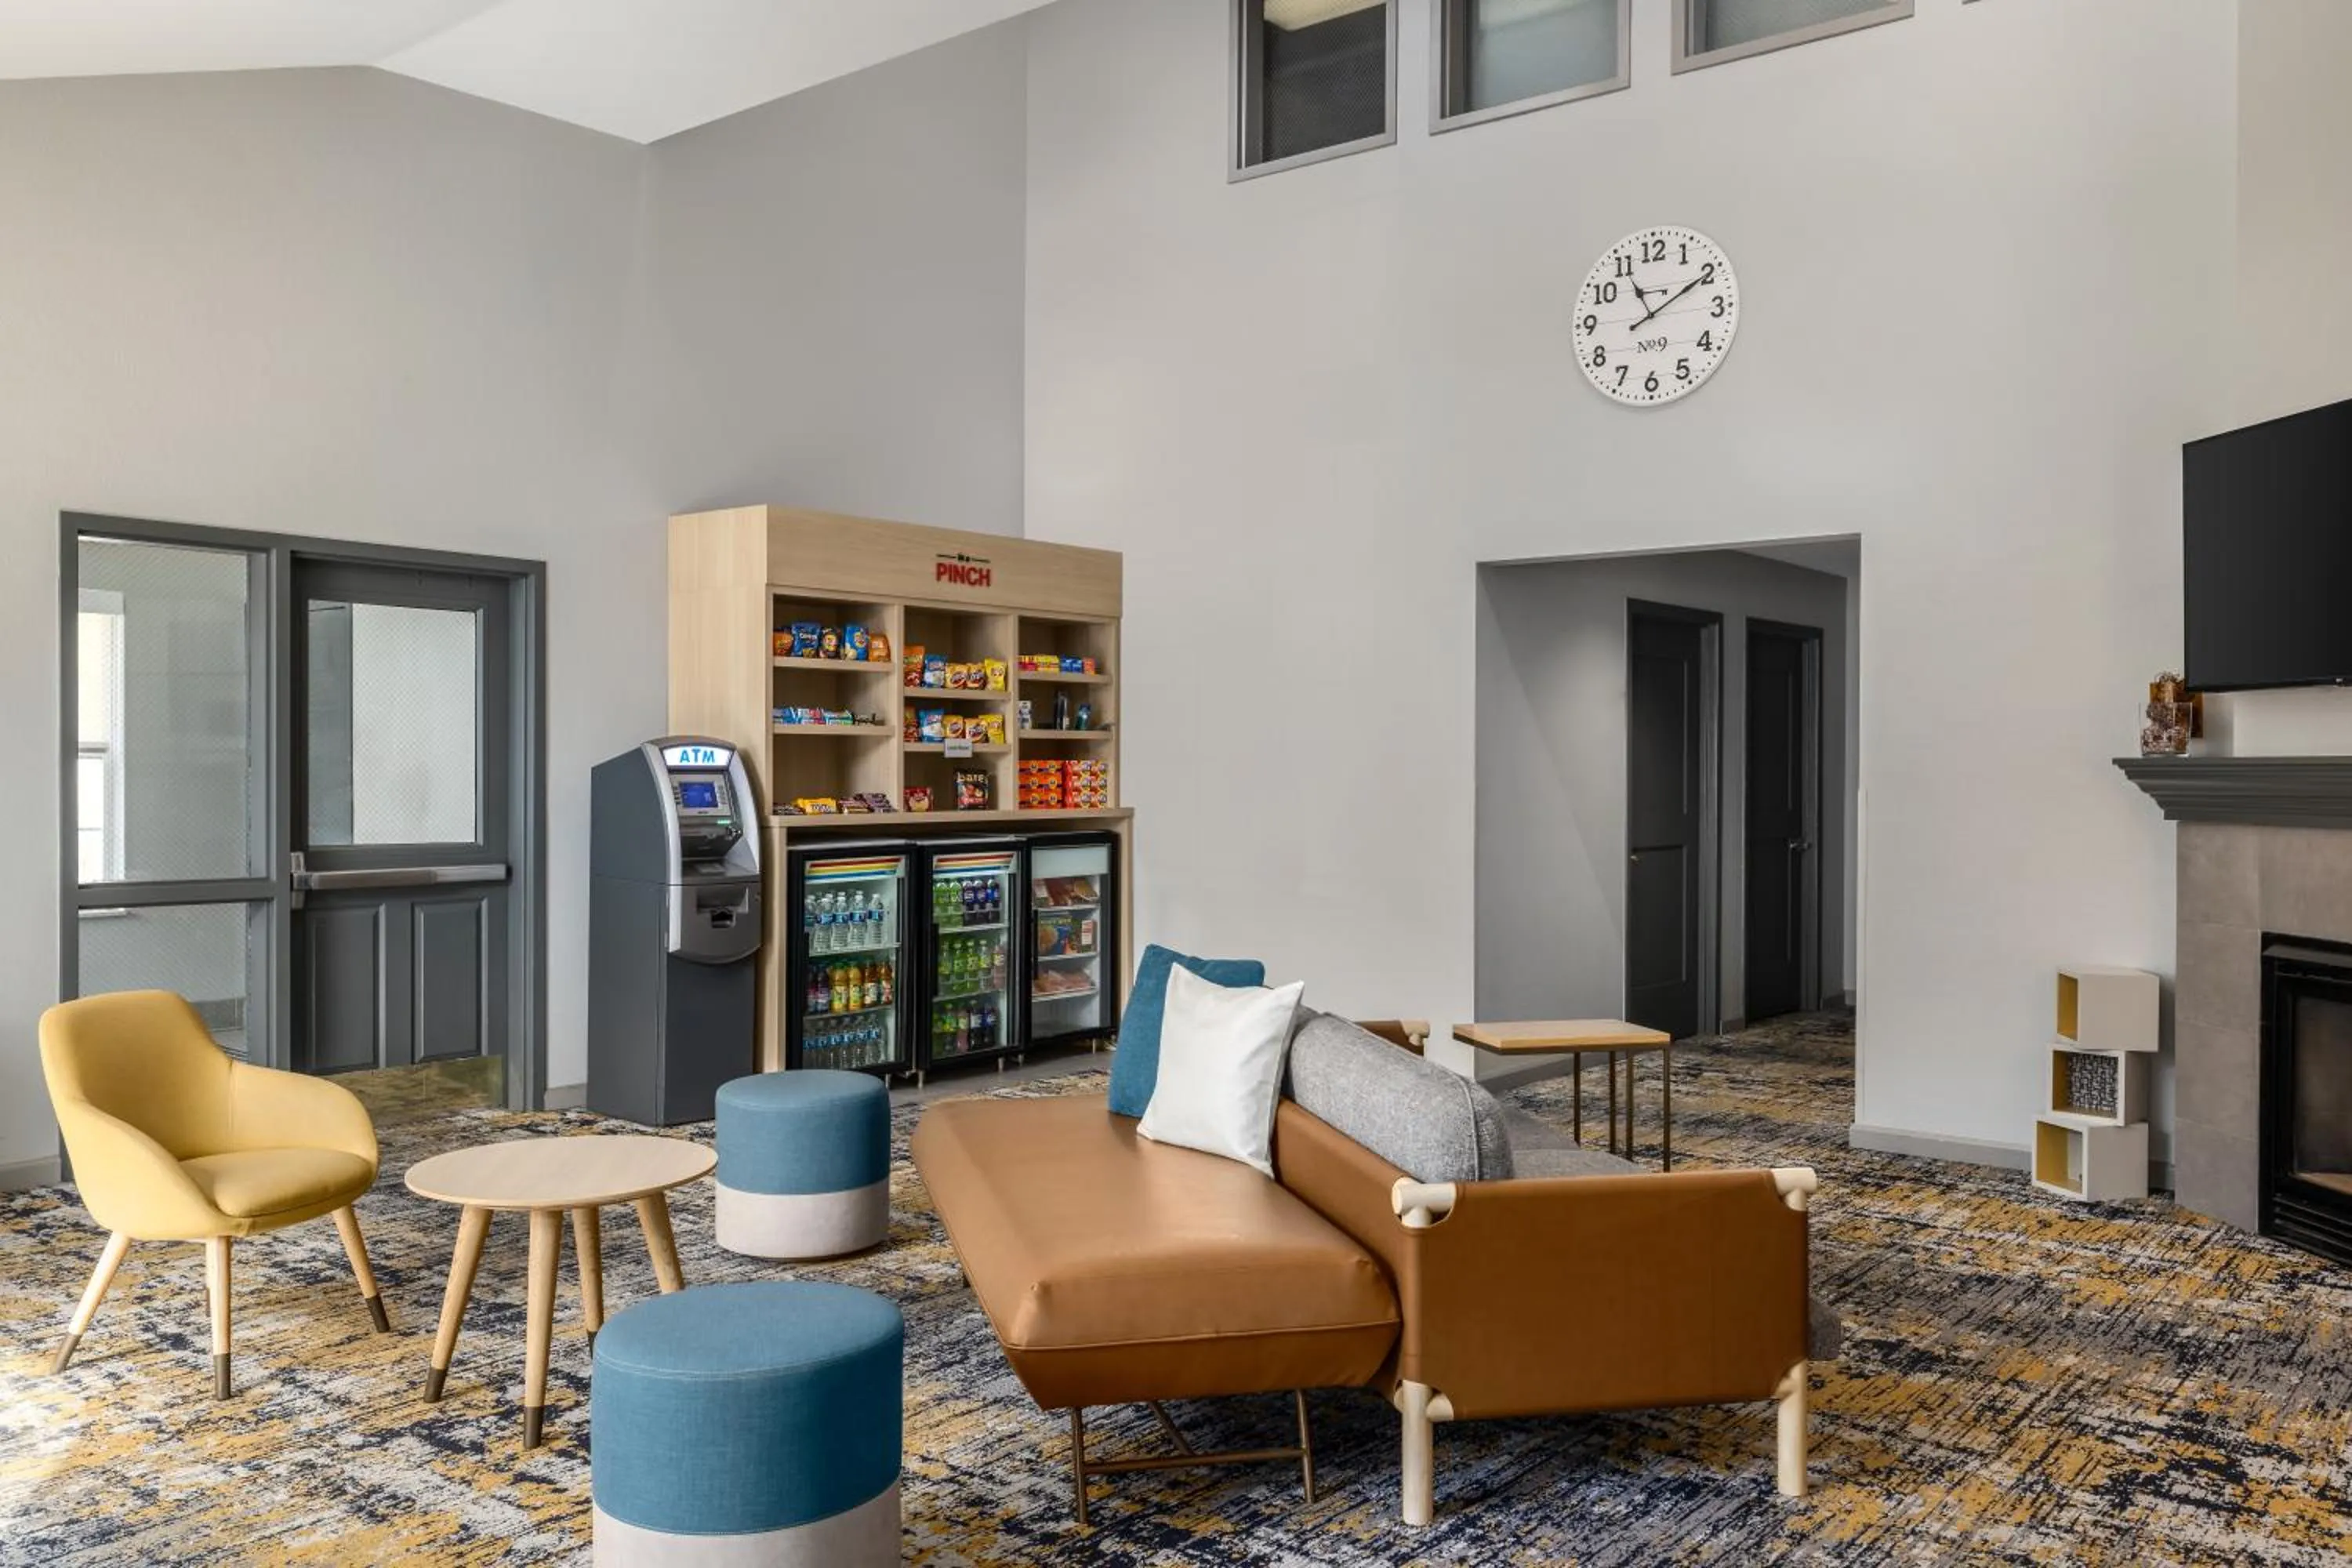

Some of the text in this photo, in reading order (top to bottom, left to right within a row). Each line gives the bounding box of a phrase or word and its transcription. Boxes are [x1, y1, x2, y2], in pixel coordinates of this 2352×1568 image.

[1642, 240, 1665, 263] 12
[1679, 244, 1688, 265] 1
[1615, 256, 1634, 278] 11
[1701, 263, 1715, 285] 2
[1594, 282, 1617, 305] 10
[1711, 296, 1724, 318] 3
[1584, 315, 1597, 336] 9
[1697, 331, 1712, 351] 4
[1593, 346, 1606, 367] 8
[1615, 365, 1629, 387] 7
[1675, 358, 1690, 379] 5
[1645, 371, 1659, 392] 6
[936, 563, 991, 586] PINCH
[680, 749, 715, 763] ATM
